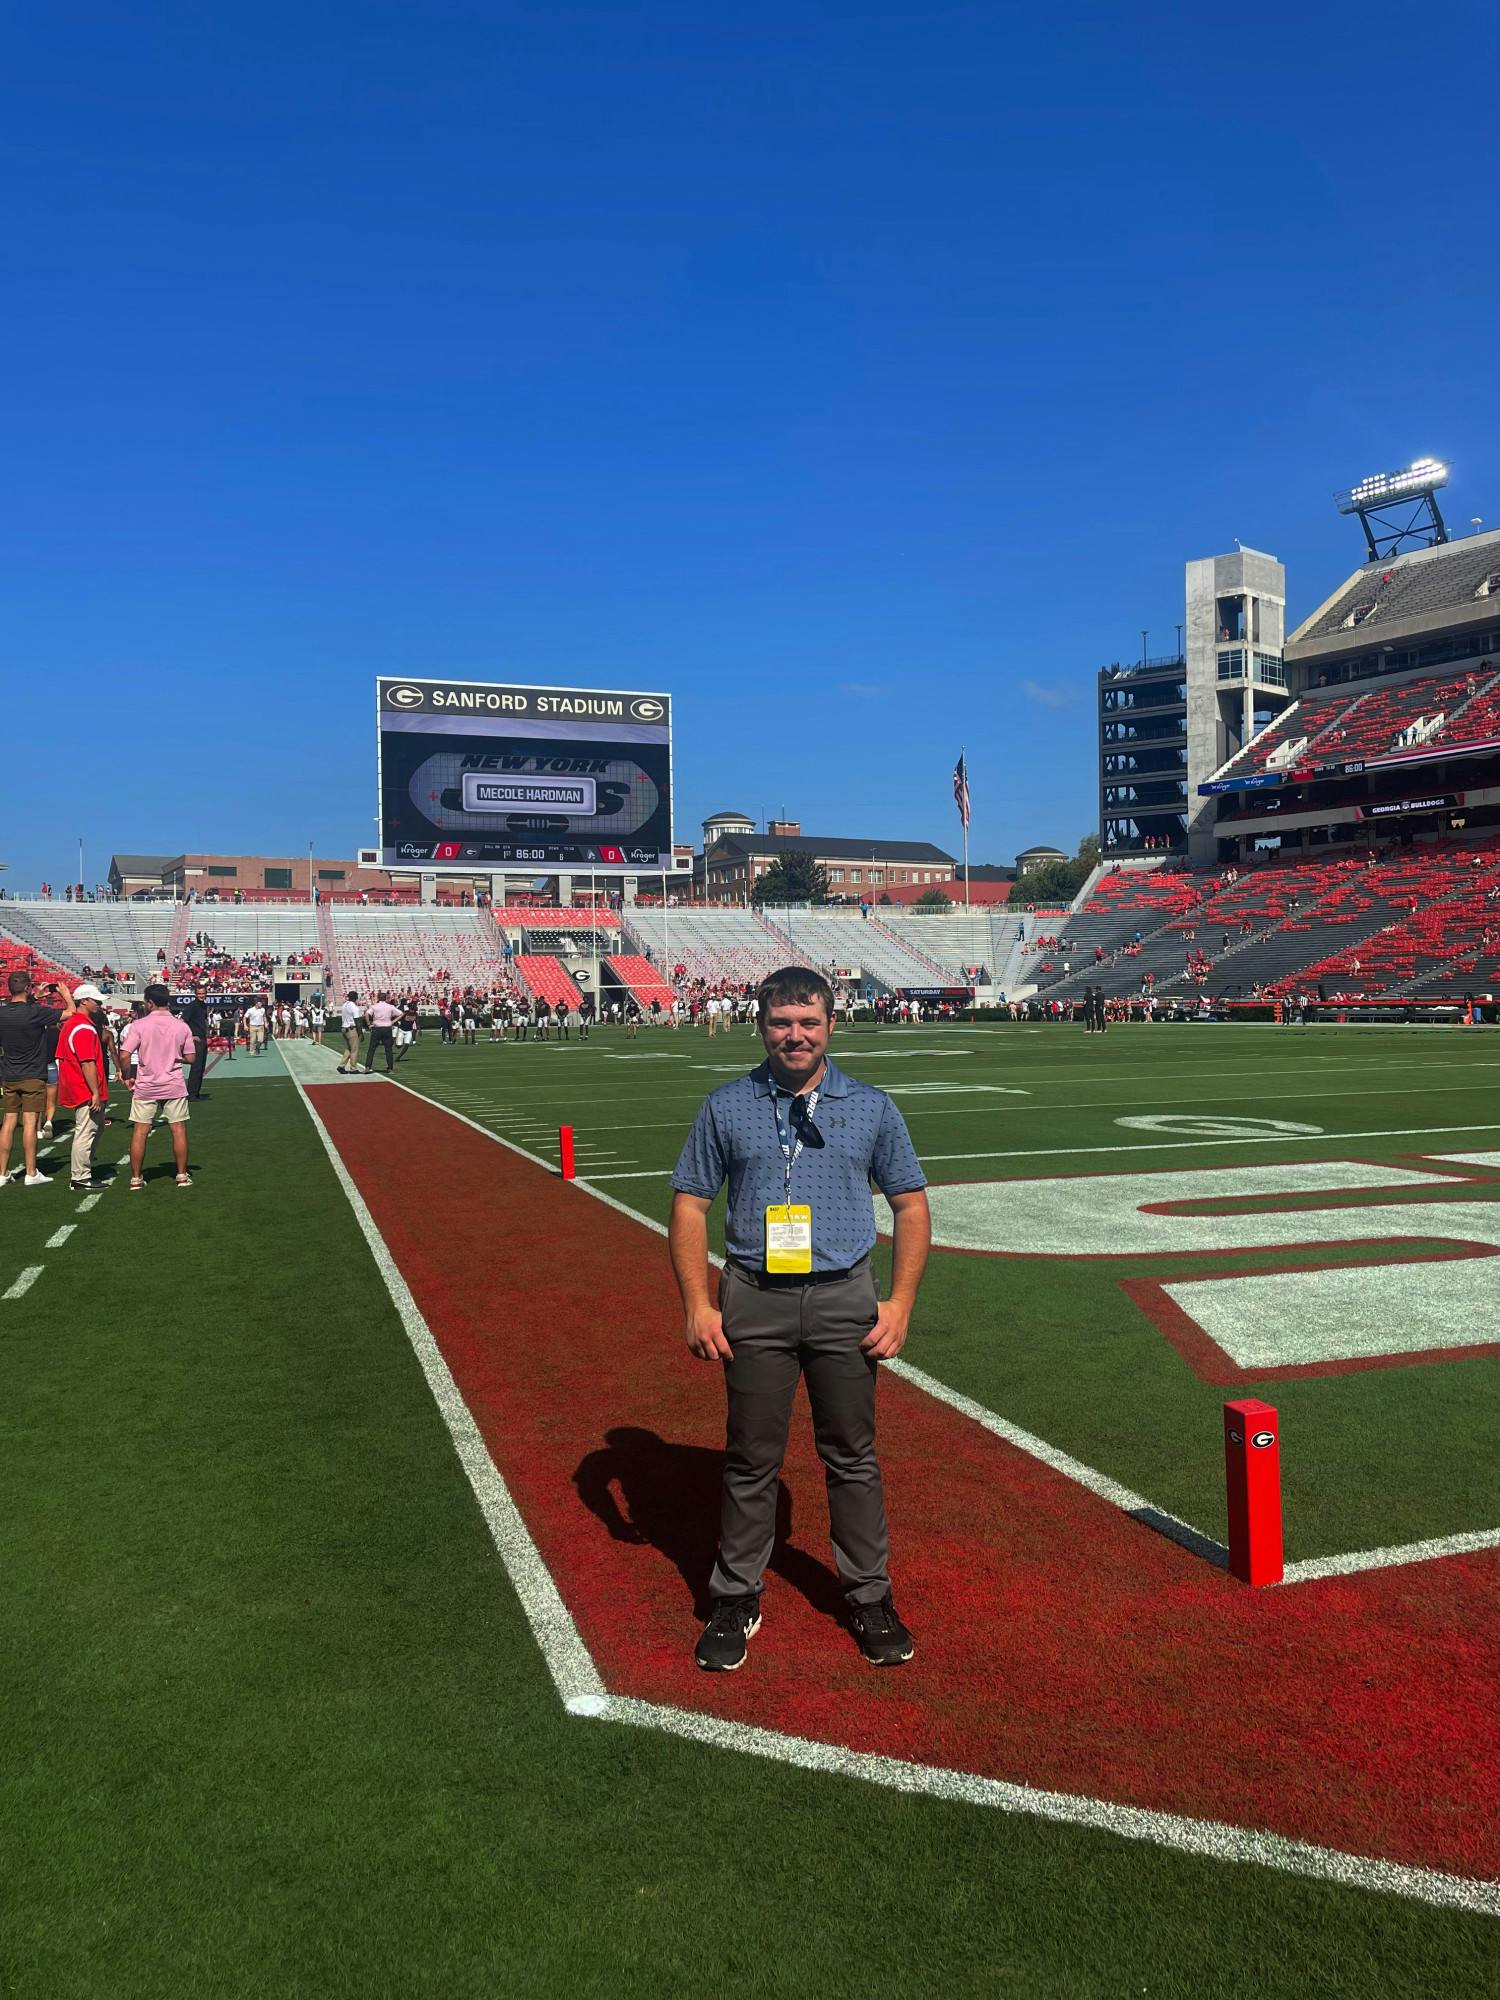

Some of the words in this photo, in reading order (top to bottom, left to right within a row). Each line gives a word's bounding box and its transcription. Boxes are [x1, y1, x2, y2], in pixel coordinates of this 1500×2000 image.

[432, 690, 528, 711] SANFORD
[537, 697, 623, 716] STADIUM
[460, 754, 530, 769] NEW
[535, 757, 611, 773] YORK
[480, 787, 524, 800] MECOLE
[526, 789, 581, 802] HARDMAN
[1372, 804, 1401, 814] GEORGIA
[1410, 798, 1445, 809] BULLDOGS
[400, 843, 428, 858] Kroger
[516, 849, 545, 859] 86:00
[631, 848, 656, 863] Kroger
